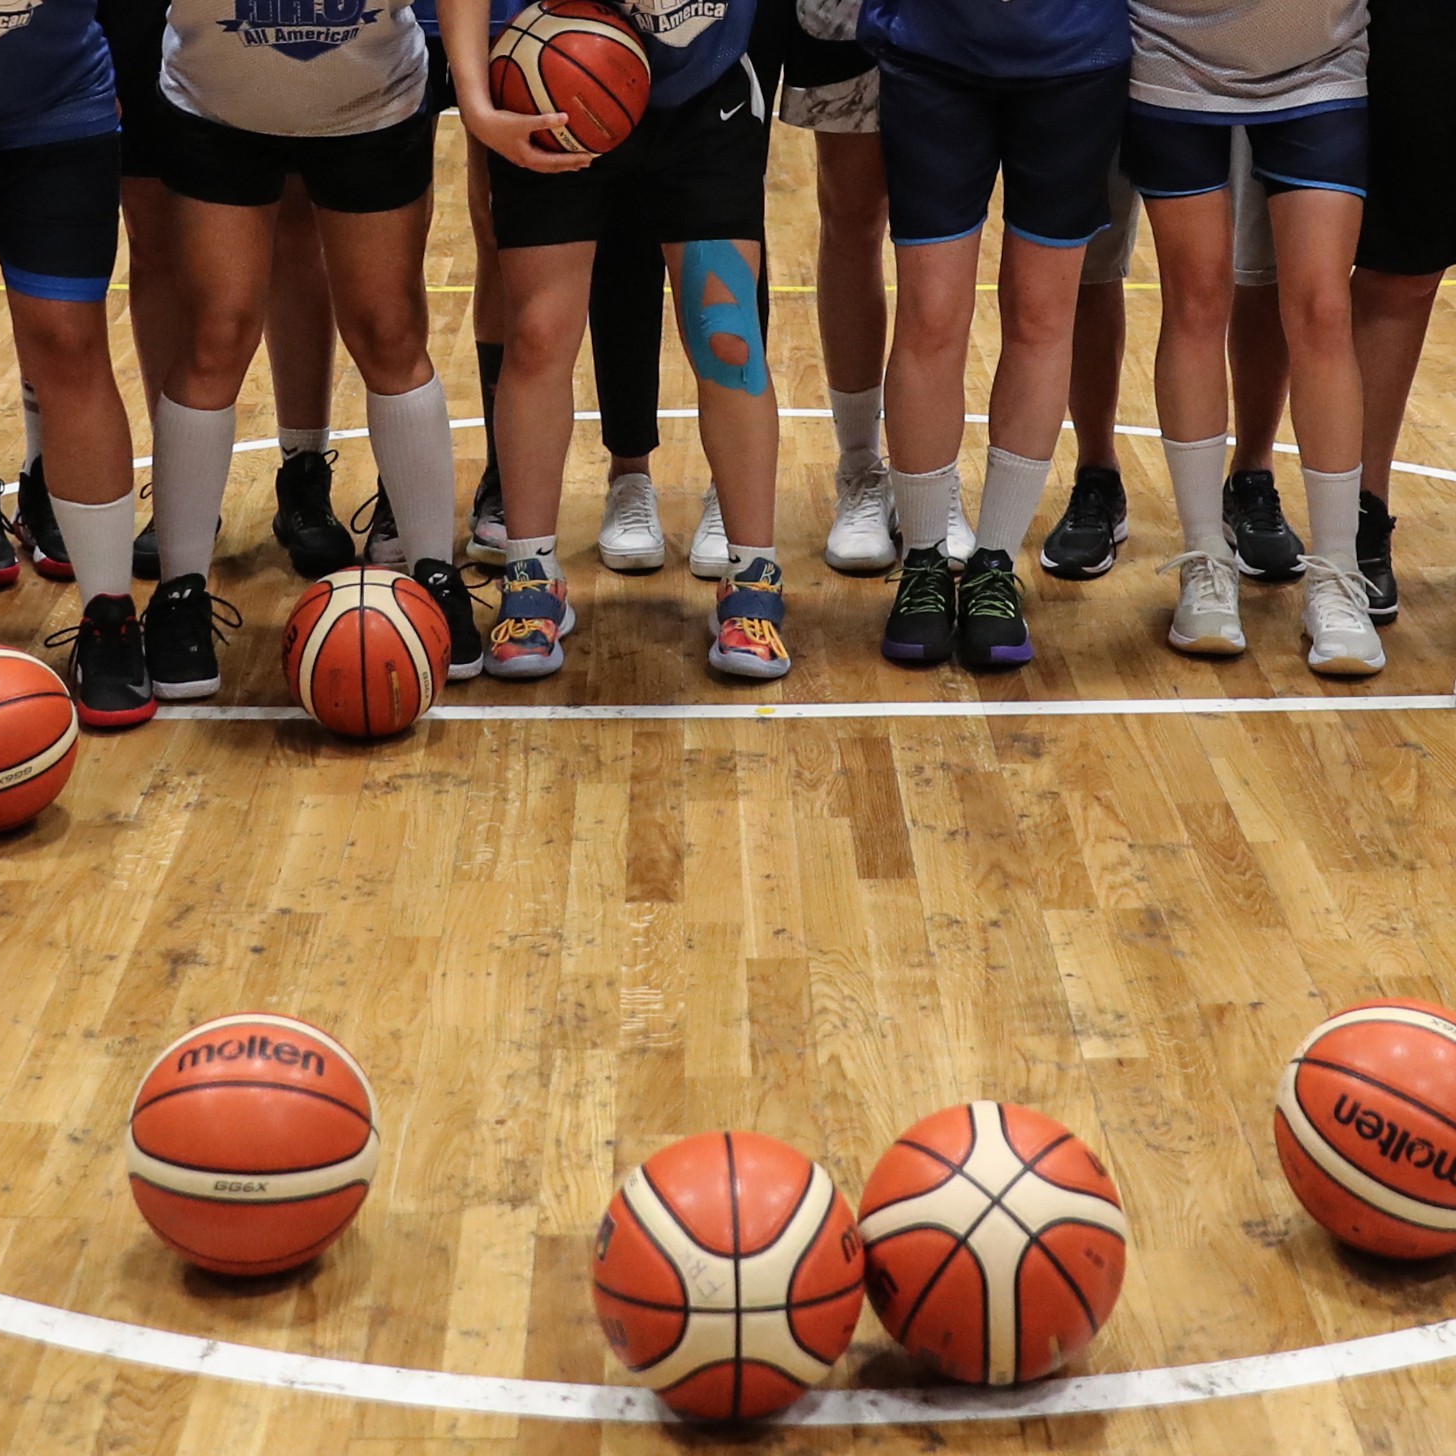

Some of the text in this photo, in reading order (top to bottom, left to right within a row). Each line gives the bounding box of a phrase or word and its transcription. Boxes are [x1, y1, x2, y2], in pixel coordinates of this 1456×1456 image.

[244, 27, 359, 45] All American
[178, 1035, 325, 1077] molten
[214, 1180, 269, 1192] GG6X
